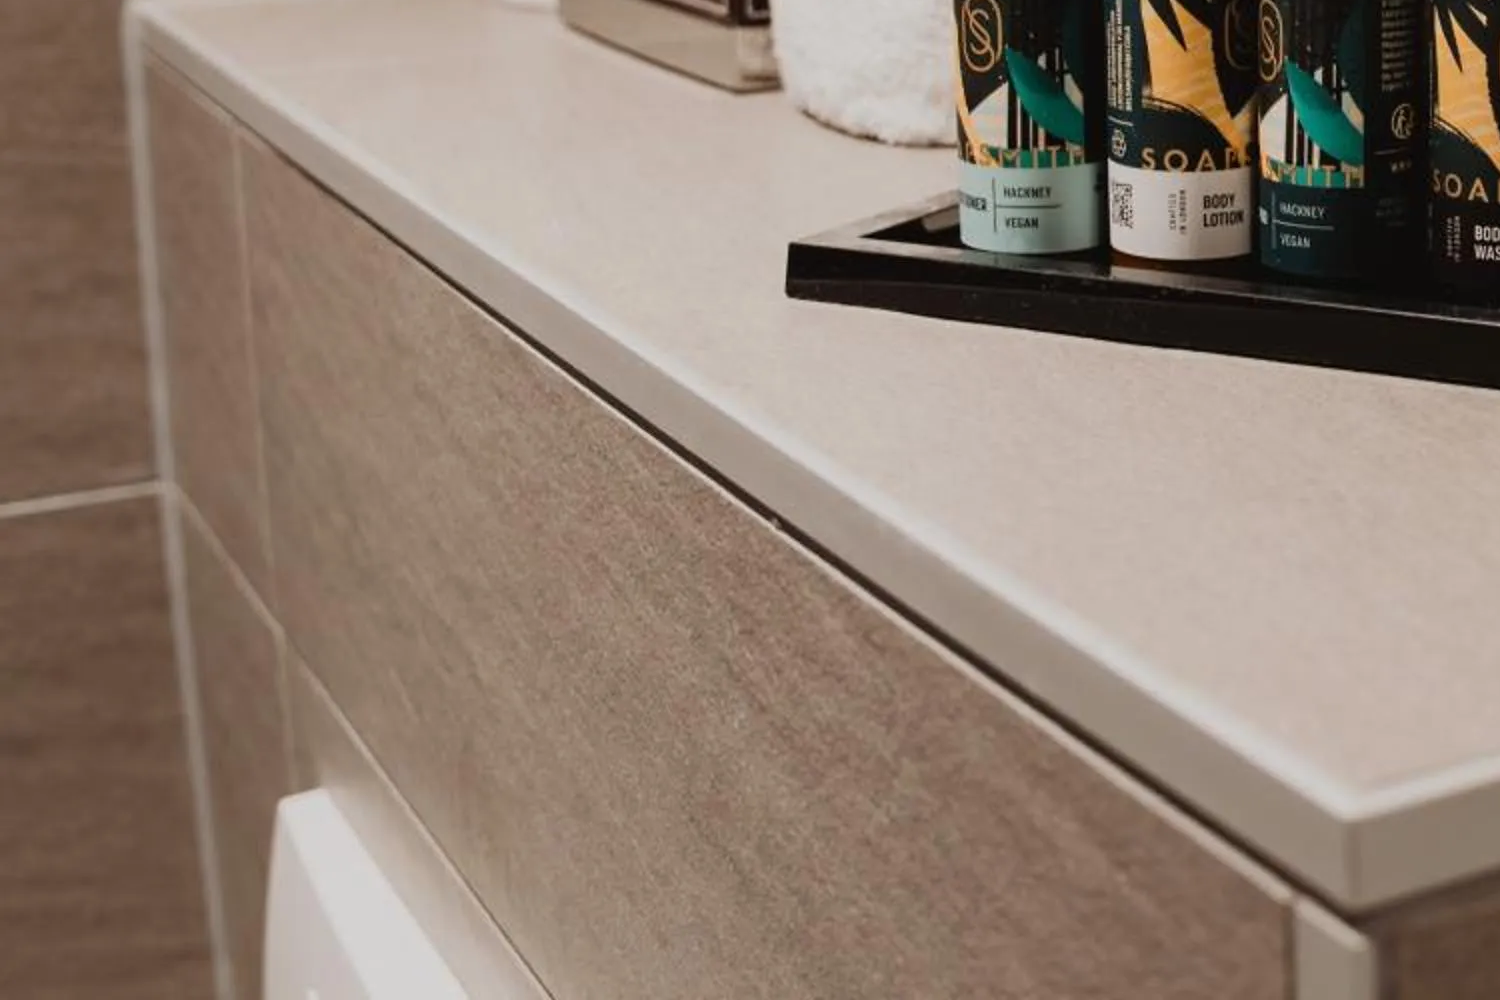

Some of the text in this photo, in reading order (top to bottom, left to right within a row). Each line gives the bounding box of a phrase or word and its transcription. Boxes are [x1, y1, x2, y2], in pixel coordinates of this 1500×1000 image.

[1003, 186, 1051, 199] HACKNEY
[1203, 193, 1235, 209] BODY
[1203, 210, 1245, 228] LOTION
[1280, 201, 1327, 220] HACKNEY
[1005, 216, 1039, 229] VEGAN
[1280, 231, 1311, 249] VEGAN
